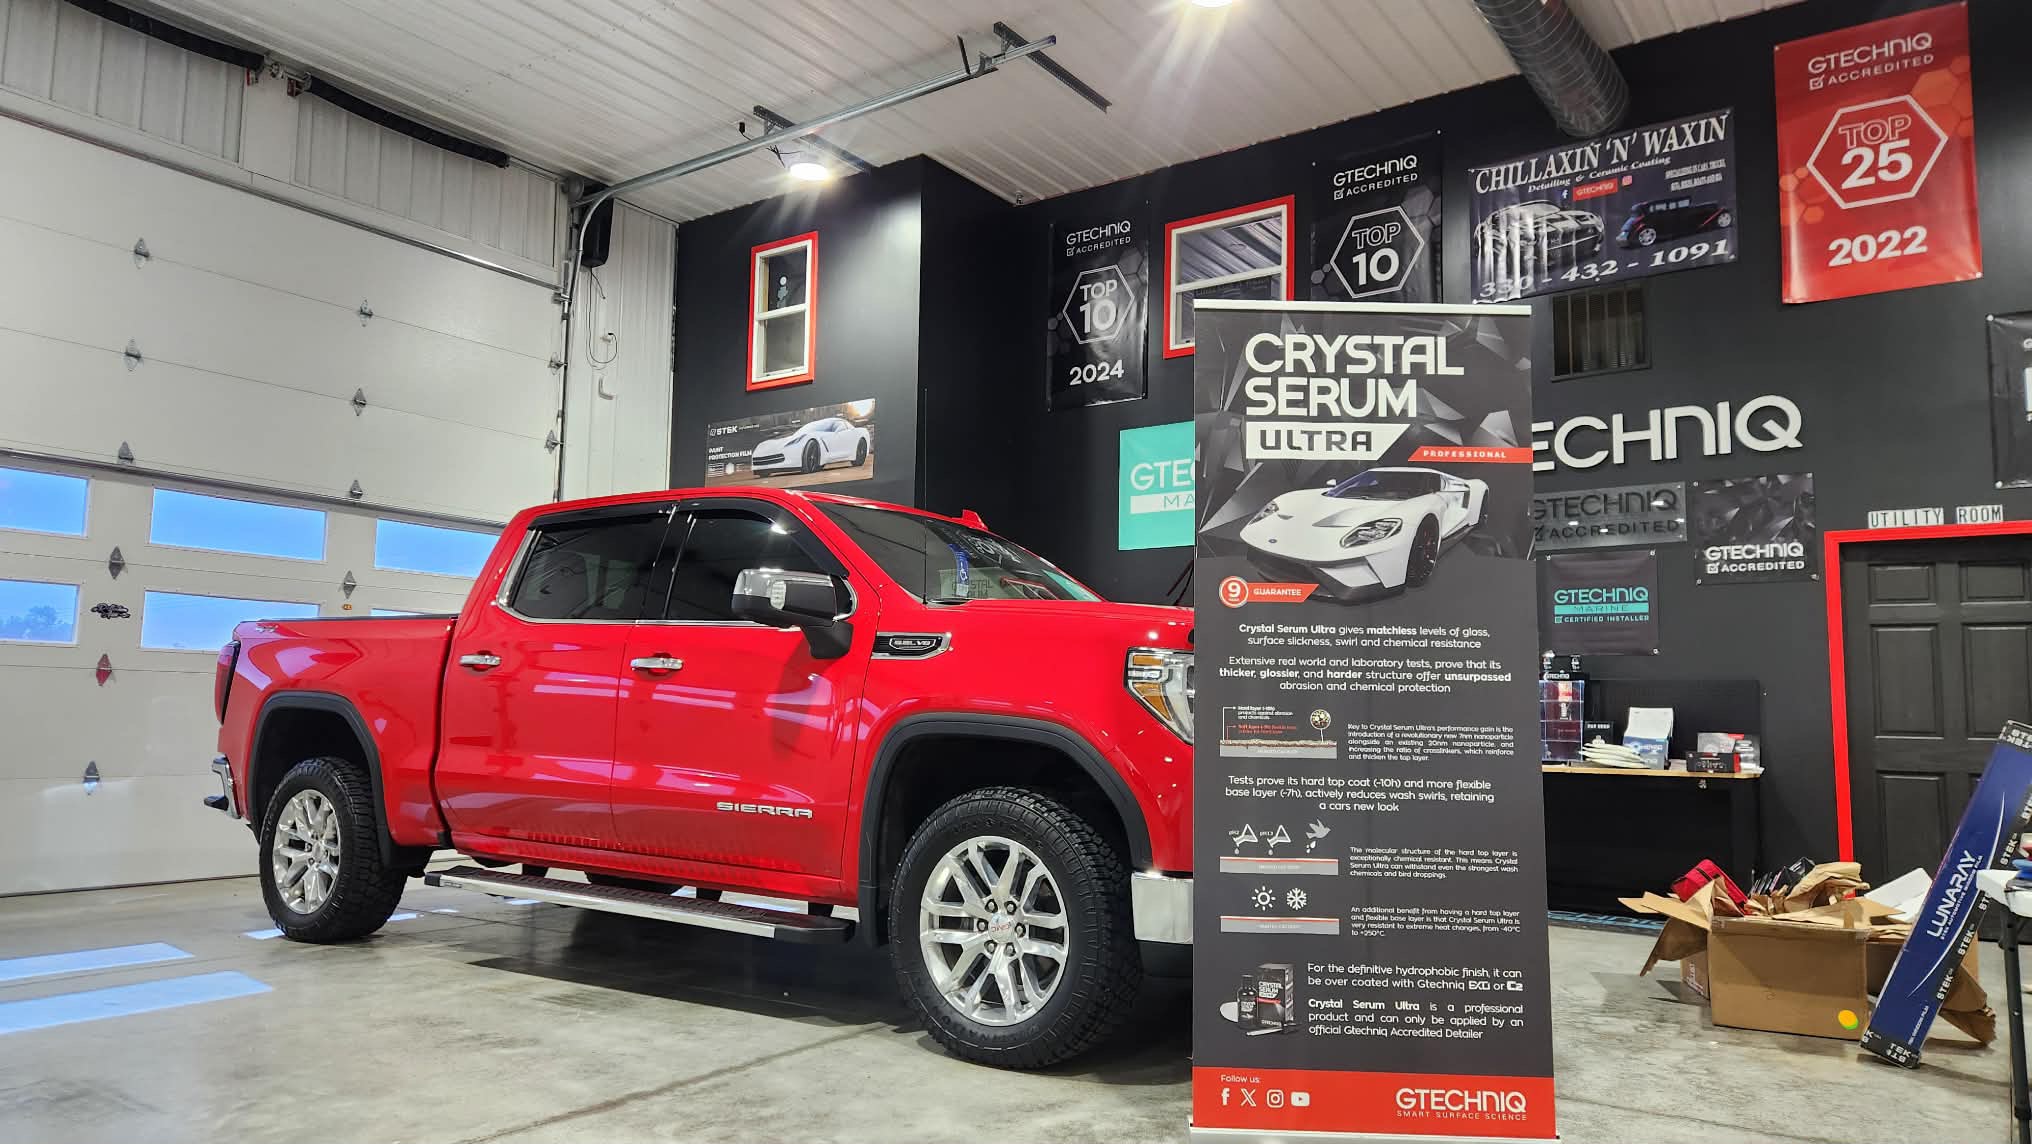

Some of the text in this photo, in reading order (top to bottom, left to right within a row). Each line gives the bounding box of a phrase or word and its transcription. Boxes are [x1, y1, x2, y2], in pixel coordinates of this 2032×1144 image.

[1808, 32, 1932, 75] GTECHNIQ
[1828, 54, 1934, 85] ACCREDITED
[1839, 114, 1912, 149] TOP
[1476, 143, 1602, 194] CHILLAXIN
[1642, 114, 1728, 156] WAXIN
[1841, 138, 1913, 190] 25
[1334, 155, 1417, 186] GTECHNIQ
[1528, 178, 1570, 192] Detailing
[1576, 174, 1584, 182] &
[1589, 165, 1629, 179] Ceramic
[1631, 156, 1671, 170] Coating
[1346, 173, 1418, 196] ACCREDITED
[1066, 220, 1131, 245] GTECHNIQ
[1352, 222, 1400, 249] TOP
[1076, 236, 1131, 254] ACCREDITED
[1828, 225, 1928, 267] 2022
[1352, 248, 1399, 286] 10
[1561, 260, 1618, 282] 432
[1650, 239, 1729, 267] 1091
[1080, 280, 1117, 301] TOP
[1080, 299, 1116, 333] 10
[1245, 333, 1464, 376] CRYSTAL
[1070, 360, 1124, 385] 2024
[1245, 377, 1416, 418] SERUM
[1260, 429, 1372, 452] ULTRA
[1423, 450, 1506, 458] PROFESSIONAL
[1130, 458, 1195, 491] GTE
[1871, 506, 2002, 527] UTILITY ROOM
[1550, 519, 1680, 538] ACCREDITED
[1705, 542, 1804, 561] GTECHNIQ
[1721, 560, 1805, 573] ACCREDITED
[1228, 582, 1240, 597] 9
[1253, 588, 1302, 596] GUARANTEE
[1554, 587, 1648, 604] GTECHNIQ
[1574, 605, 1630, 613] MARINE
[1239, 624, 1490, 637] Crystal Serum Ultra gives matchless levels of gloss,
[1247, 636, 1481, 648] surface slickness, swirl and chemical resistance
[1228, 656, 1501, 669] Extensive real world and laboratory tests, prove that its
[1219, 667, 1511, 682] thicker, glossier, and harder structure offer unsurpassed
[1279, 681, 1450, 694] abrasion and chemical protection
[1228, 775, 1254, 784] Tests
[1256, 777, 1284, 786] prove
[1287, 776, 1298, 785] its
[1301, 776, 1324, 785] hard
[1327, 777, 1345, 787] top
[1347, 777, 1370, 786] coat
[1403, 778, 1423, 787] and
[1426, 780, 1453, 788] more
[1455, 779, 1491, 790] flexible
[1225, 787, 1250, 796] base
[1252, 787, 1277, 798] layer
[1304, 788, 1343, 800] actively
[1346, 789, 1386, 799] reduces
[1388, 790, 1415, 799] wash
[1418, 791, 1447, 801] swirls,
[1450, 791, 1494, 803] retaining
[716, 802, 812, 818] SIERRA
[1377, 802, 1399, 811] look
[2000, 838, 2018, 865] STEK
[1926, 850, 1975, 938] LUNARAY
[1958, 931, 1975, 956] STEK
[1307, 963, 1325, 972] For
[1327, 963, 1344, 972] the
[1347, 964, 1392, 975] definitive
[1395, 965, 1459, 977] hydrophobic
[1462, 967, 1490, 978] finish,
[1493, 968, 1499, 977] it
[1307, 975, 1321, 985] be
[1351, 977, 1388, 987] coated
[1391, 978, 1414, 987] with
[1416, 979, 1464, 991] Gtechniq
[1936, 975, 1953, 1000] STEK
[1308, 998, 1342, 1009] Crystal
[1352, 999, 1385, 1009] Serum
[1395, 1000, 1419, 1010] Ultra
[1429, 1002, 1437, 1010] is
[1464, 1003, 1523, 1015] professional
[1308, 1012, 1348, 1022] product
[1354, 1013, 1374, 1022] and
[1404, 1014, 1425, 1025] only
[1431, 1014, 1444, 1024] be
[1449, 1015, 1486, 1027] applied
[1492, 1016, 1504, 1028] by
[1308, 1025, 1483, 1038] official Gtechniq Accredited Detailer
[1220, 1074, 1247, 1082] Follow
[1396, 1088, 1526, 1112] GTECHNIQ
